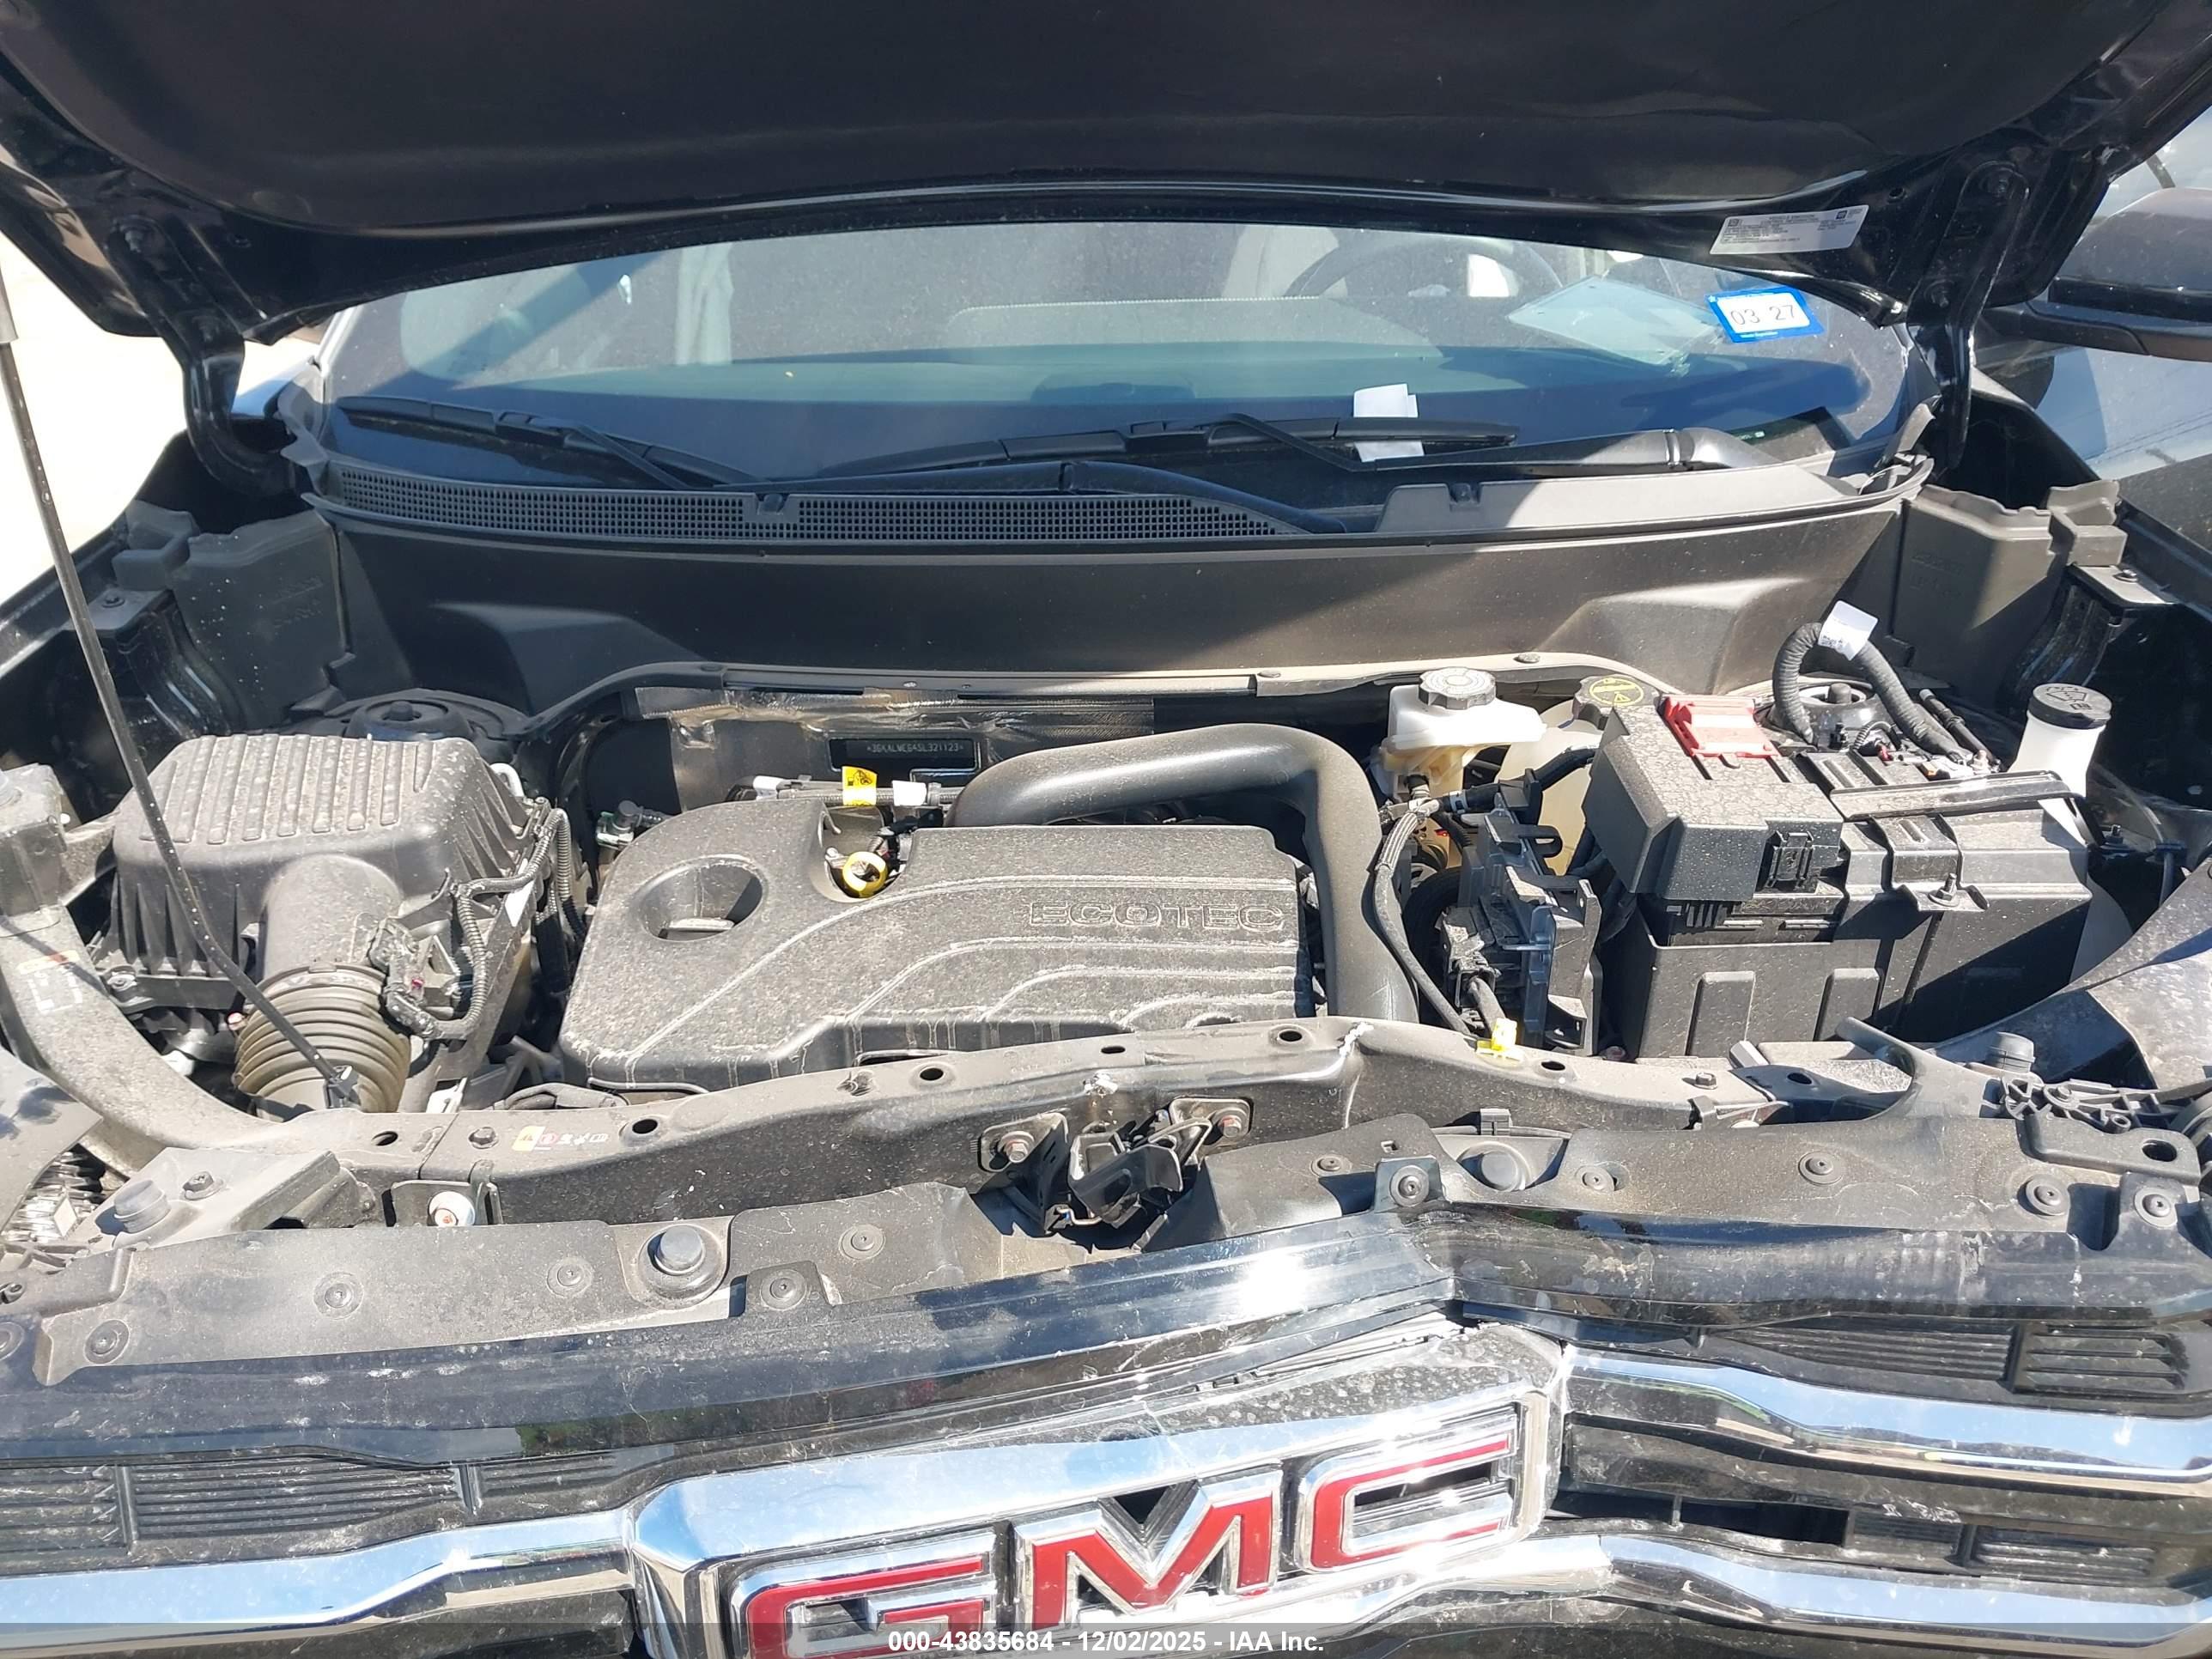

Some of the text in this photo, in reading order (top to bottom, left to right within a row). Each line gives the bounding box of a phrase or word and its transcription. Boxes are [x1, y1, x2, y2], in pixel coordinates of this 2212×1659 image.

[1729, 304, 1796, 325] 03 27
[1029, 901, 1285, 933] ECOTEC
[730, 1405, 1520, 1659] GMC
